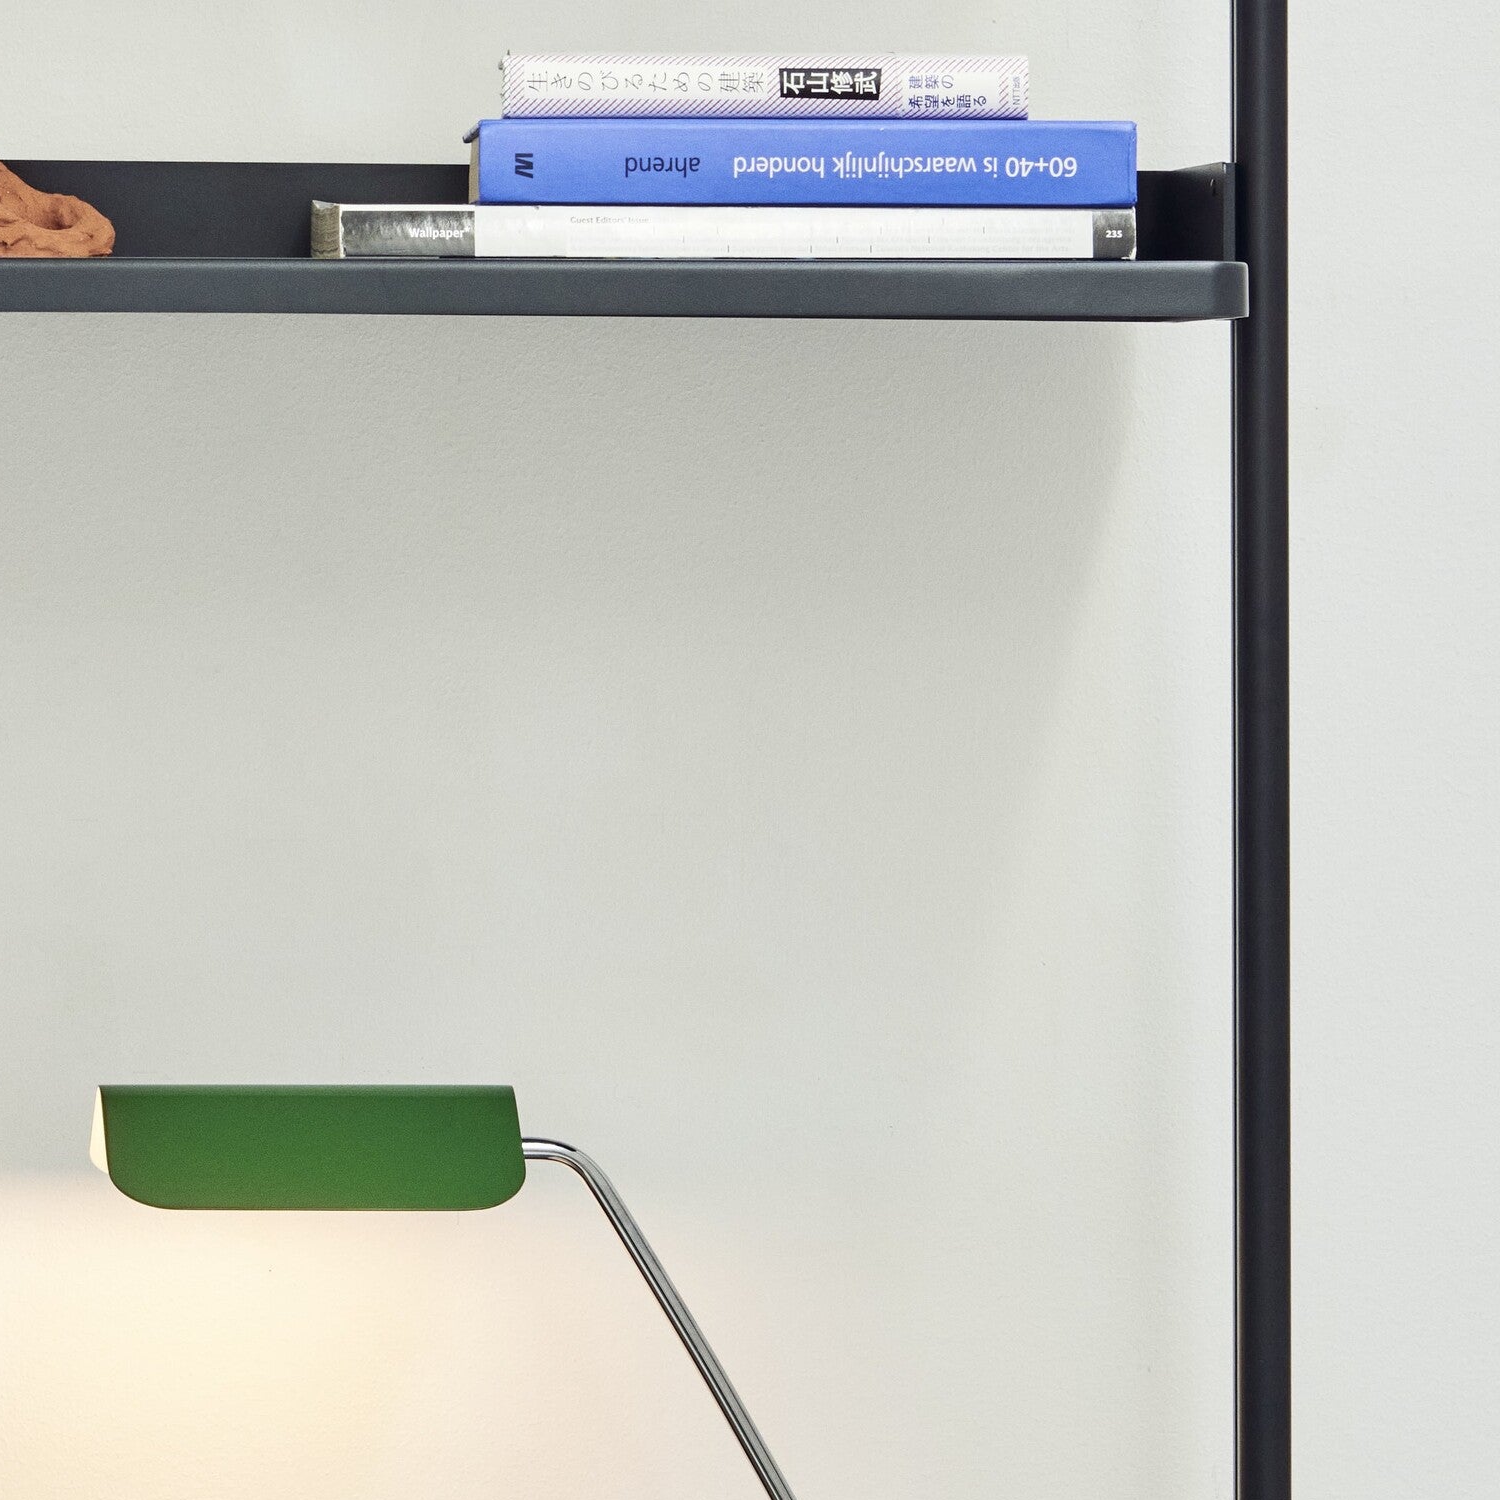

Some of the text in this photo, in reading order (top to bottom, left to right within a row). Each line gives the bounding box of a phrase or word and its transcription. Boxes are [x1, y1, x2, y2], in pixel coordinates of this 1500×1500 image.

[526, 69, 765, 94] 生きのびるための建築
[782, 70, 878, 95] 石山修武
[908, 74, 955, 90] 建築の
[908, 94, 987, 109] 希望を語る
[624, 156, 701, 178] ahrend
[733, 151, 1078, 178] 60+40 is waarschijnlijk honderd
[1106, 229, 1123, 239] 235
